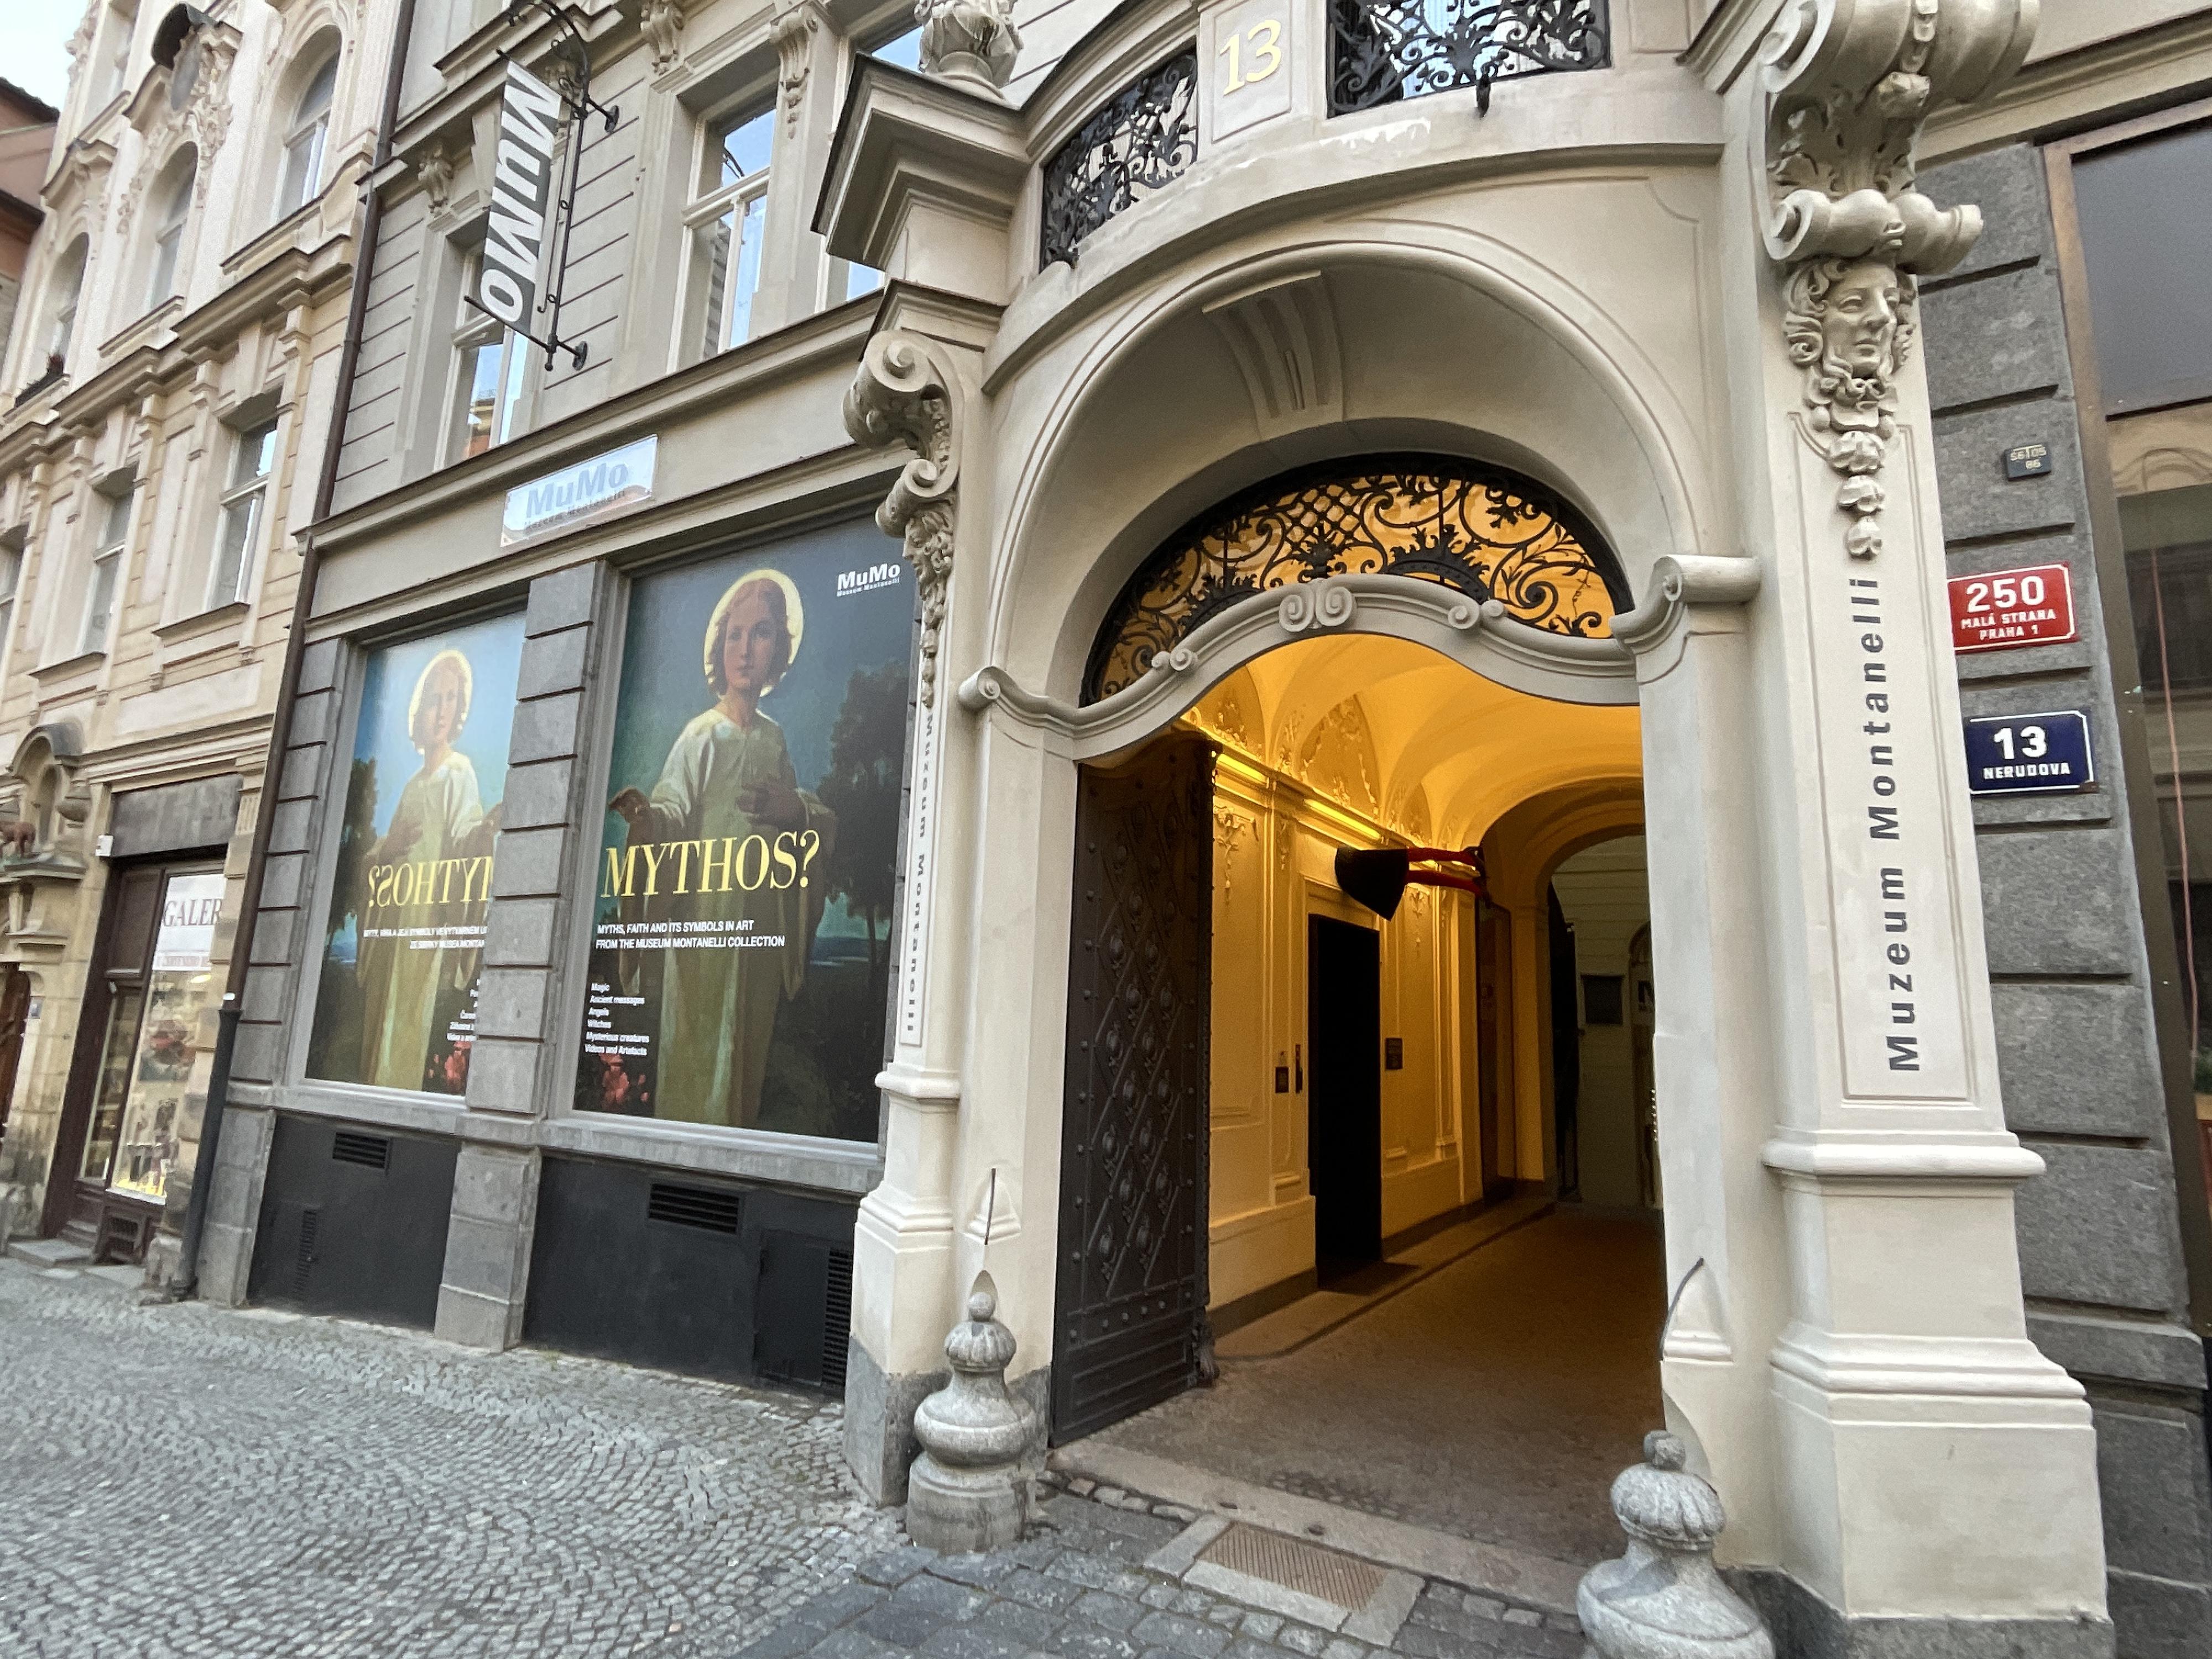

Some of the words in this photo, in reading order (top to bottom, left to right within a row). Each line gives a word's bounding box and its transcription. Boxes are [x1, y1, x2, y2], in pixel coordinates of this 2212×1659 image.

[1219, 19, 1282, 96] 13
[481, 60, 561, 322] MuMo
[526, 462, 628, 518] MuMo
[838, 564, 900, 590] MuMo
[1966, 576, 2044, 613] 250
[1961, 613, 1996, 629] MALÁ
[2001, 609, 2057, 624] STRANA
[1979, 626, 2025, 640] PRAHA
[2031, 624, 2039, 634] 1
[1849, 578, 1900, 840] Montanelli
[1994, 726, 2047, 759] 13
[1983, 763, 2070, 779] NERUDOVA
[601, 830, 820, 898] MYTHOS?
[596, 939, 618, 949] FROM
[619, 938, 634, 949] THE
[636, 938, 671, 948] MUSEUM
[673, 937, 726, 948] MONTANELLI
[728, 935, 785, 947] COLLECTION
[597, 924, 625, 935] MYTHS,
[627, 923, 649, 933] FAITH
[650, 922, 667, 933] AND
[669, 922, 681, 932] ITS
[683, 921, 723, 932] SYMBOLS
[726, 921, 734, 931] IN
[736, 920, 754, 930] ART
[907, 854, 924, 1030] Montanelli
[1880, 868, 1919, 1071] Muzeum
